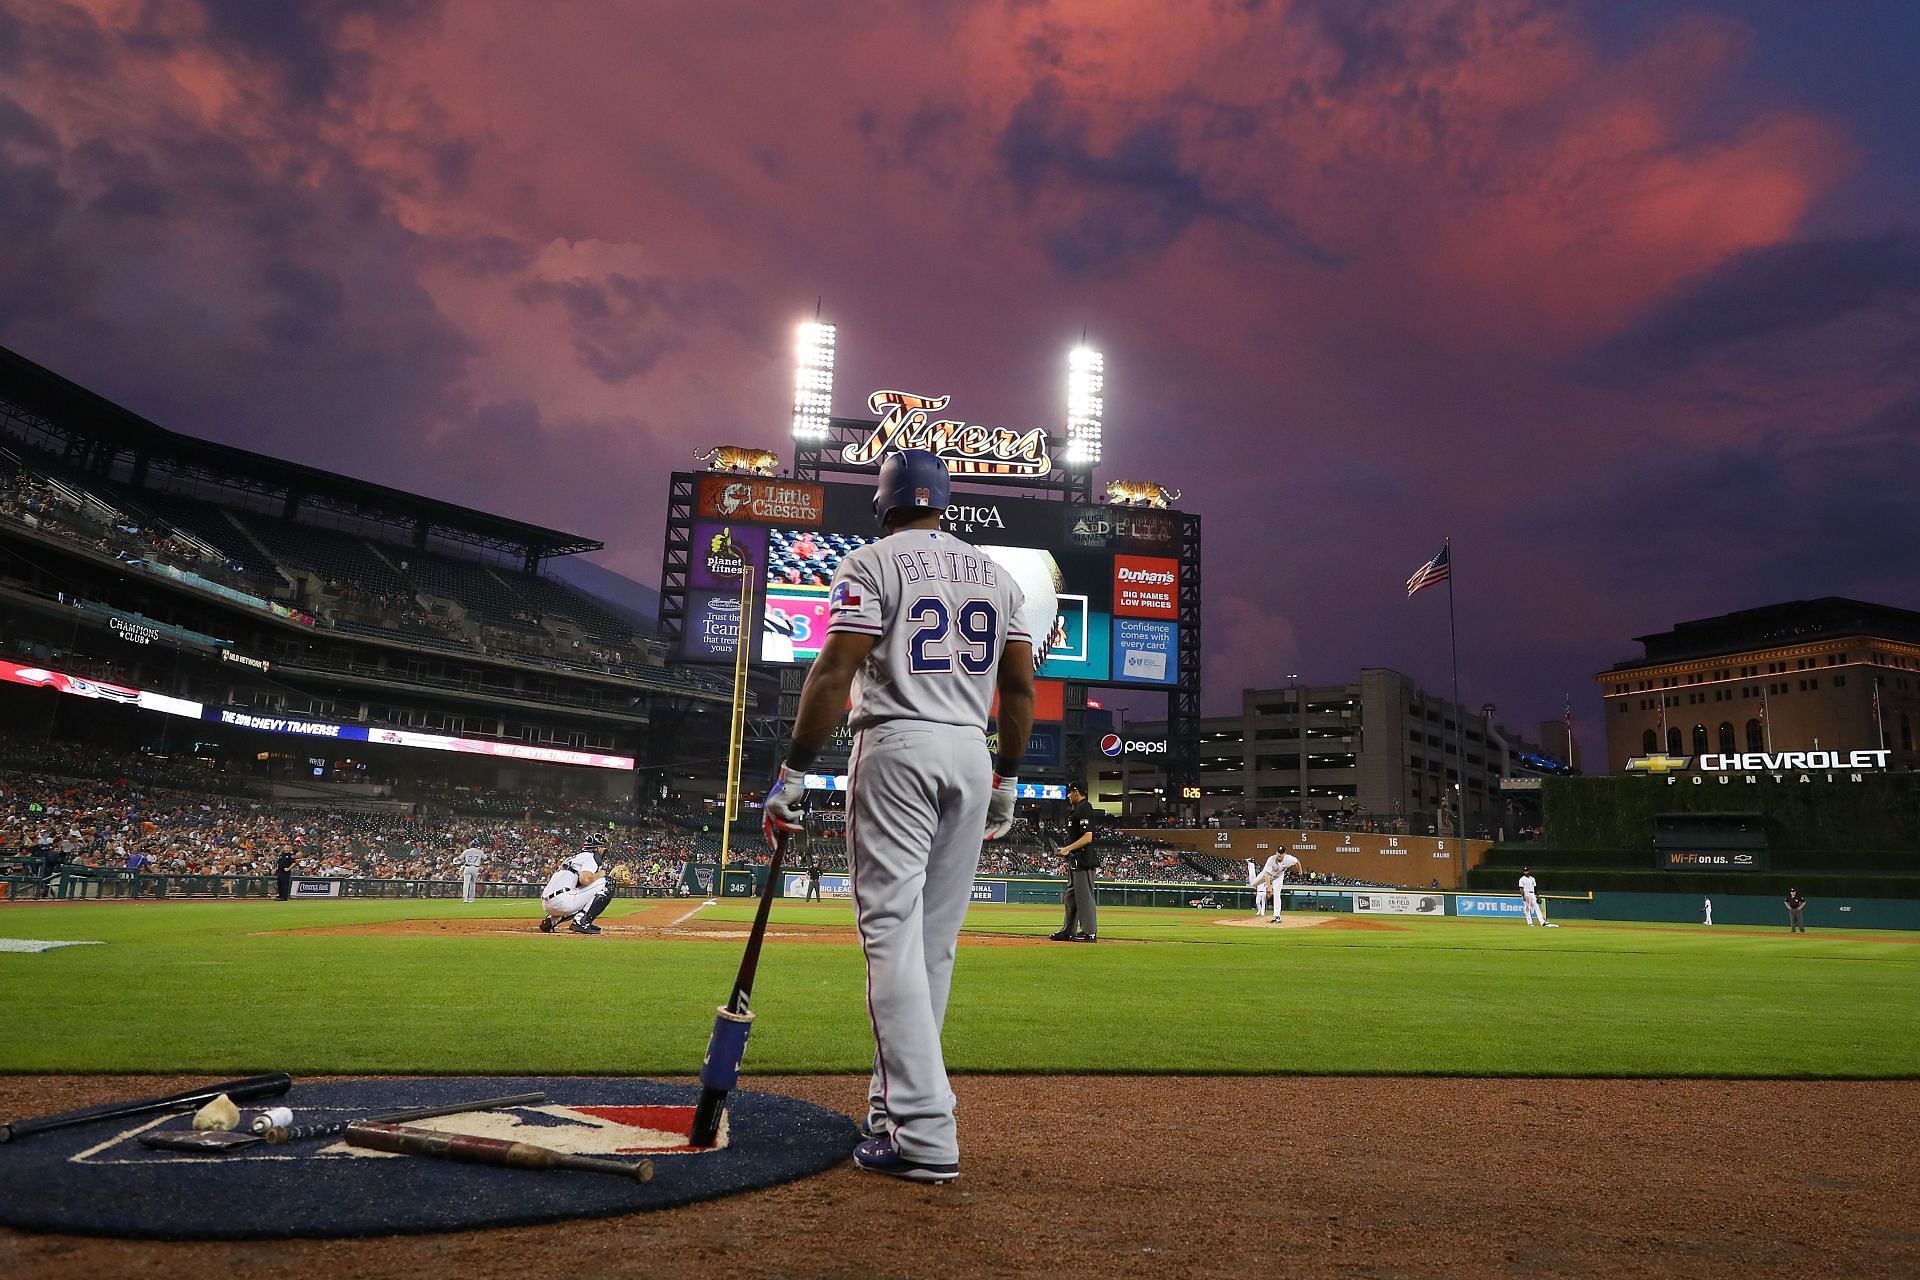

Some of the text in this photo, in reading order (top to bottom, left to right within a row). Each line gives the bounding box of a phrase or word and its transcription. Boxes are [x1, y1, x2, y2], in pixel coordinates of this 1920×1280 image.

[843, 390, 1052, 477] Tigers
[766, 486, 811, 505] Little
[752, 499, 817, 520] Caesars
[940, 504, 1006, 529] ericA
[707, 556, 742, 567] planet
[897, 550, 996, 588] BELTRE
[1118, 567, 1175, 583] Dunham's
[1140, 592, 1170, 601] NAMES
[1141, 600, 1172, 609] PRICES
[707, 612, 727, 621] Trust
[110, 617, 159, 641] CHAMPIONS
[1121, 621, 1170, 633] Confidence
[124, 632, 145, 644] CLUB
[703, 635, 740, 645] that treat
[906, 596, 999, 676] 29
[1121, 633, 1170, 641] comes with
[710, 645, 733, 653] yours
[1121, 640, 1145, 651] every
[250, 717, 287, 731] CHEVY
[287, 721, 340, 737] TRAVERSE
[1124, 740, 1167, 755] pepsi
[1699, 750, 1892, 771] CHEVROLET
[1667, 773, 1863, 786] FOUNTAIN
[1183, 787, 1201, 798] 0:26
[1217, 832, 1228, 841] 23
[1301, 833, 1307, 842] 5
[1345, 835, 1351, 845] 2
[1388, 837, 1398, 847] 16
[1438, 840, 1444, 850] 6
[468, 855, 479, 863] 27
[1671, 853, 1698, 864] Wi-Fi
[1698, 856, 1712, 864] on
[1713, 856, 1729, 864] us.
[1477, 901, 1535, 914] DTE Enery
